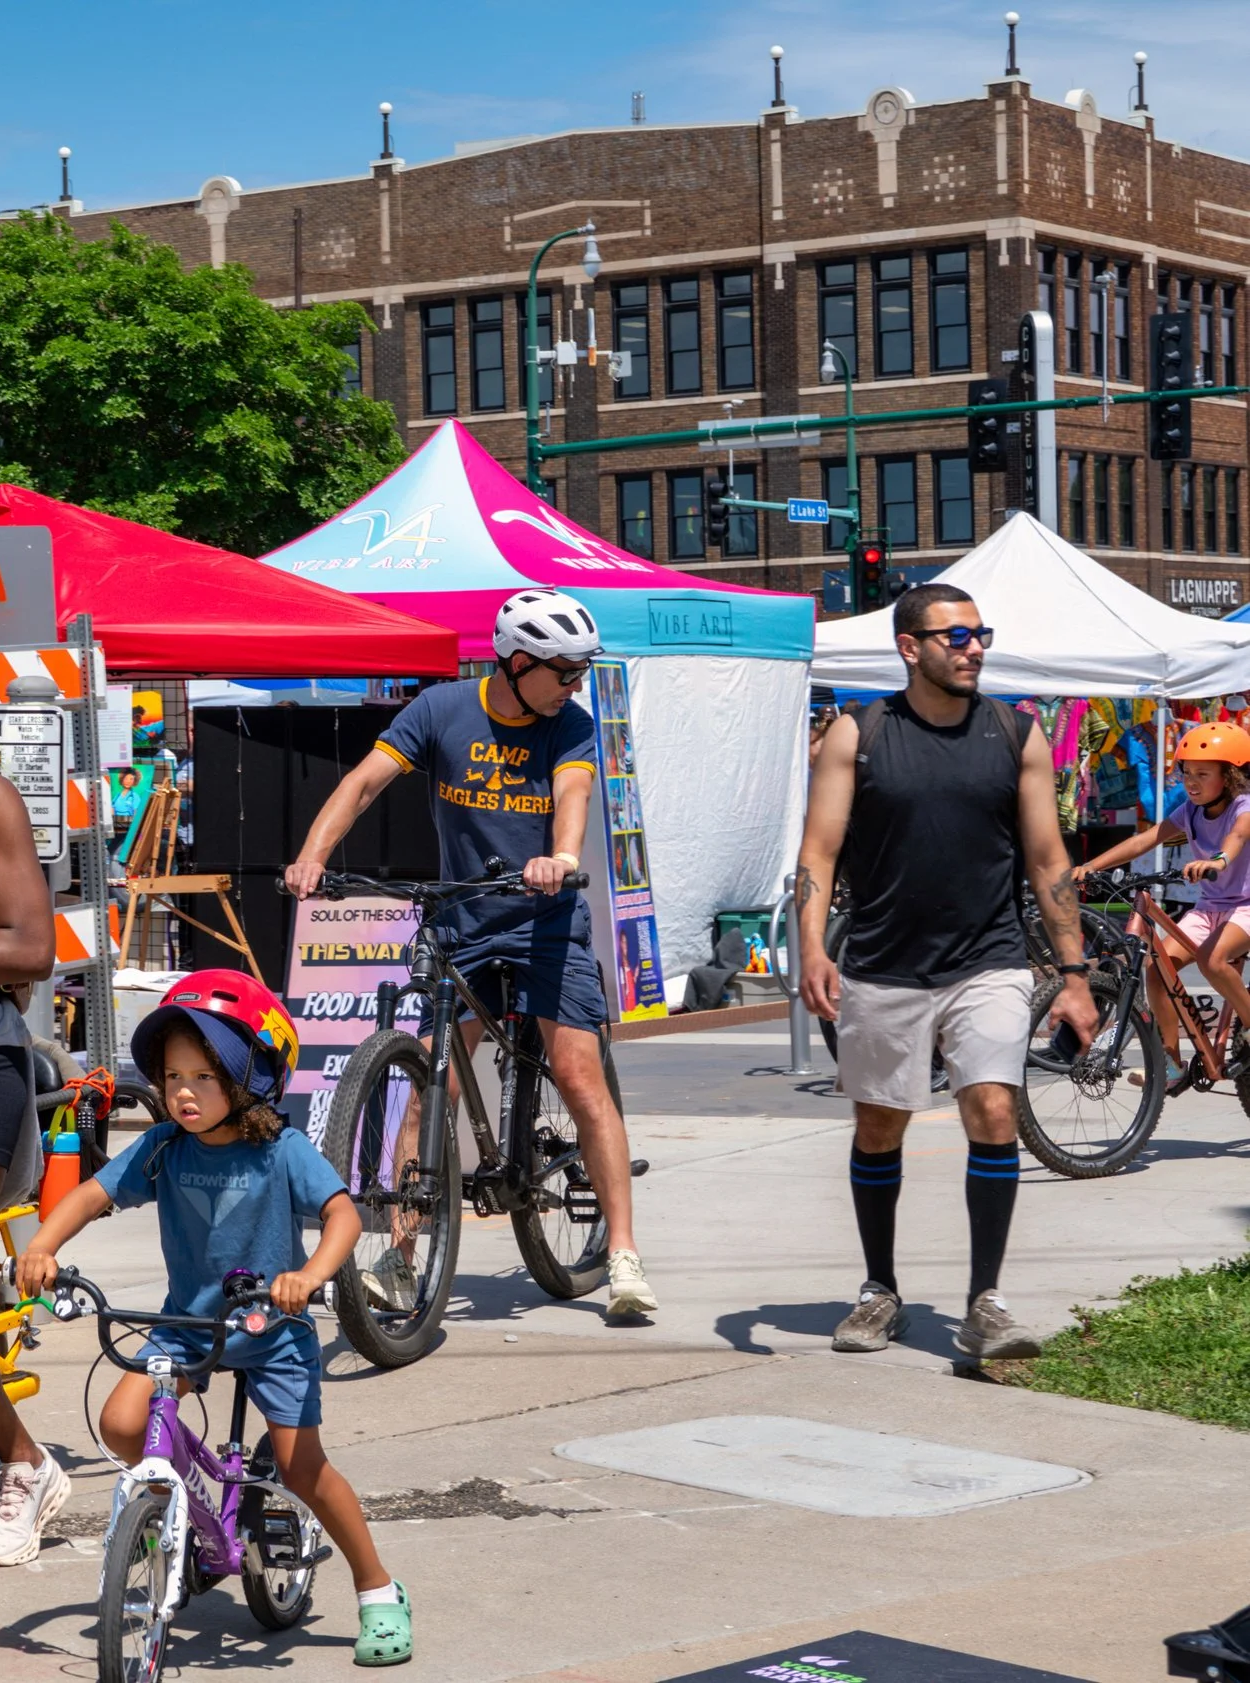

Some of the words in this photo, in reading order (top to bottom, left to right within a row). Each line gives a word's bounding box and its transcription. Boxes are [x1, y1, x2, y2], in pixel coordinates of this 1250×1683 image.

[791, 504, 796, 516] E
[798, 505, 816, 517] Lake
[818, 506, 827, 518] St
[292, 557, 364, 573] VIBE
[369, 556, 441, 571] ART
[1171, 579, 1239, 604] LAGNIAPPE
[470, 742, 530, 767] CAMP
[438, 781, 499, 810] EAGLES
[311, 909, 341, 922] SOUL
[343, 909, 362, 922] OF
[362, 909, 384, 921] THE
[298, 943, 351, 961] THIS
[355, 943, 404, 960] WAY
[303, 992, 354, 1017] FOOD
[179, 1171, 249, 1188] snowbird
[149, 1402, 165, 1450] woom
[780, 1661, 868, 1683] VOICES
